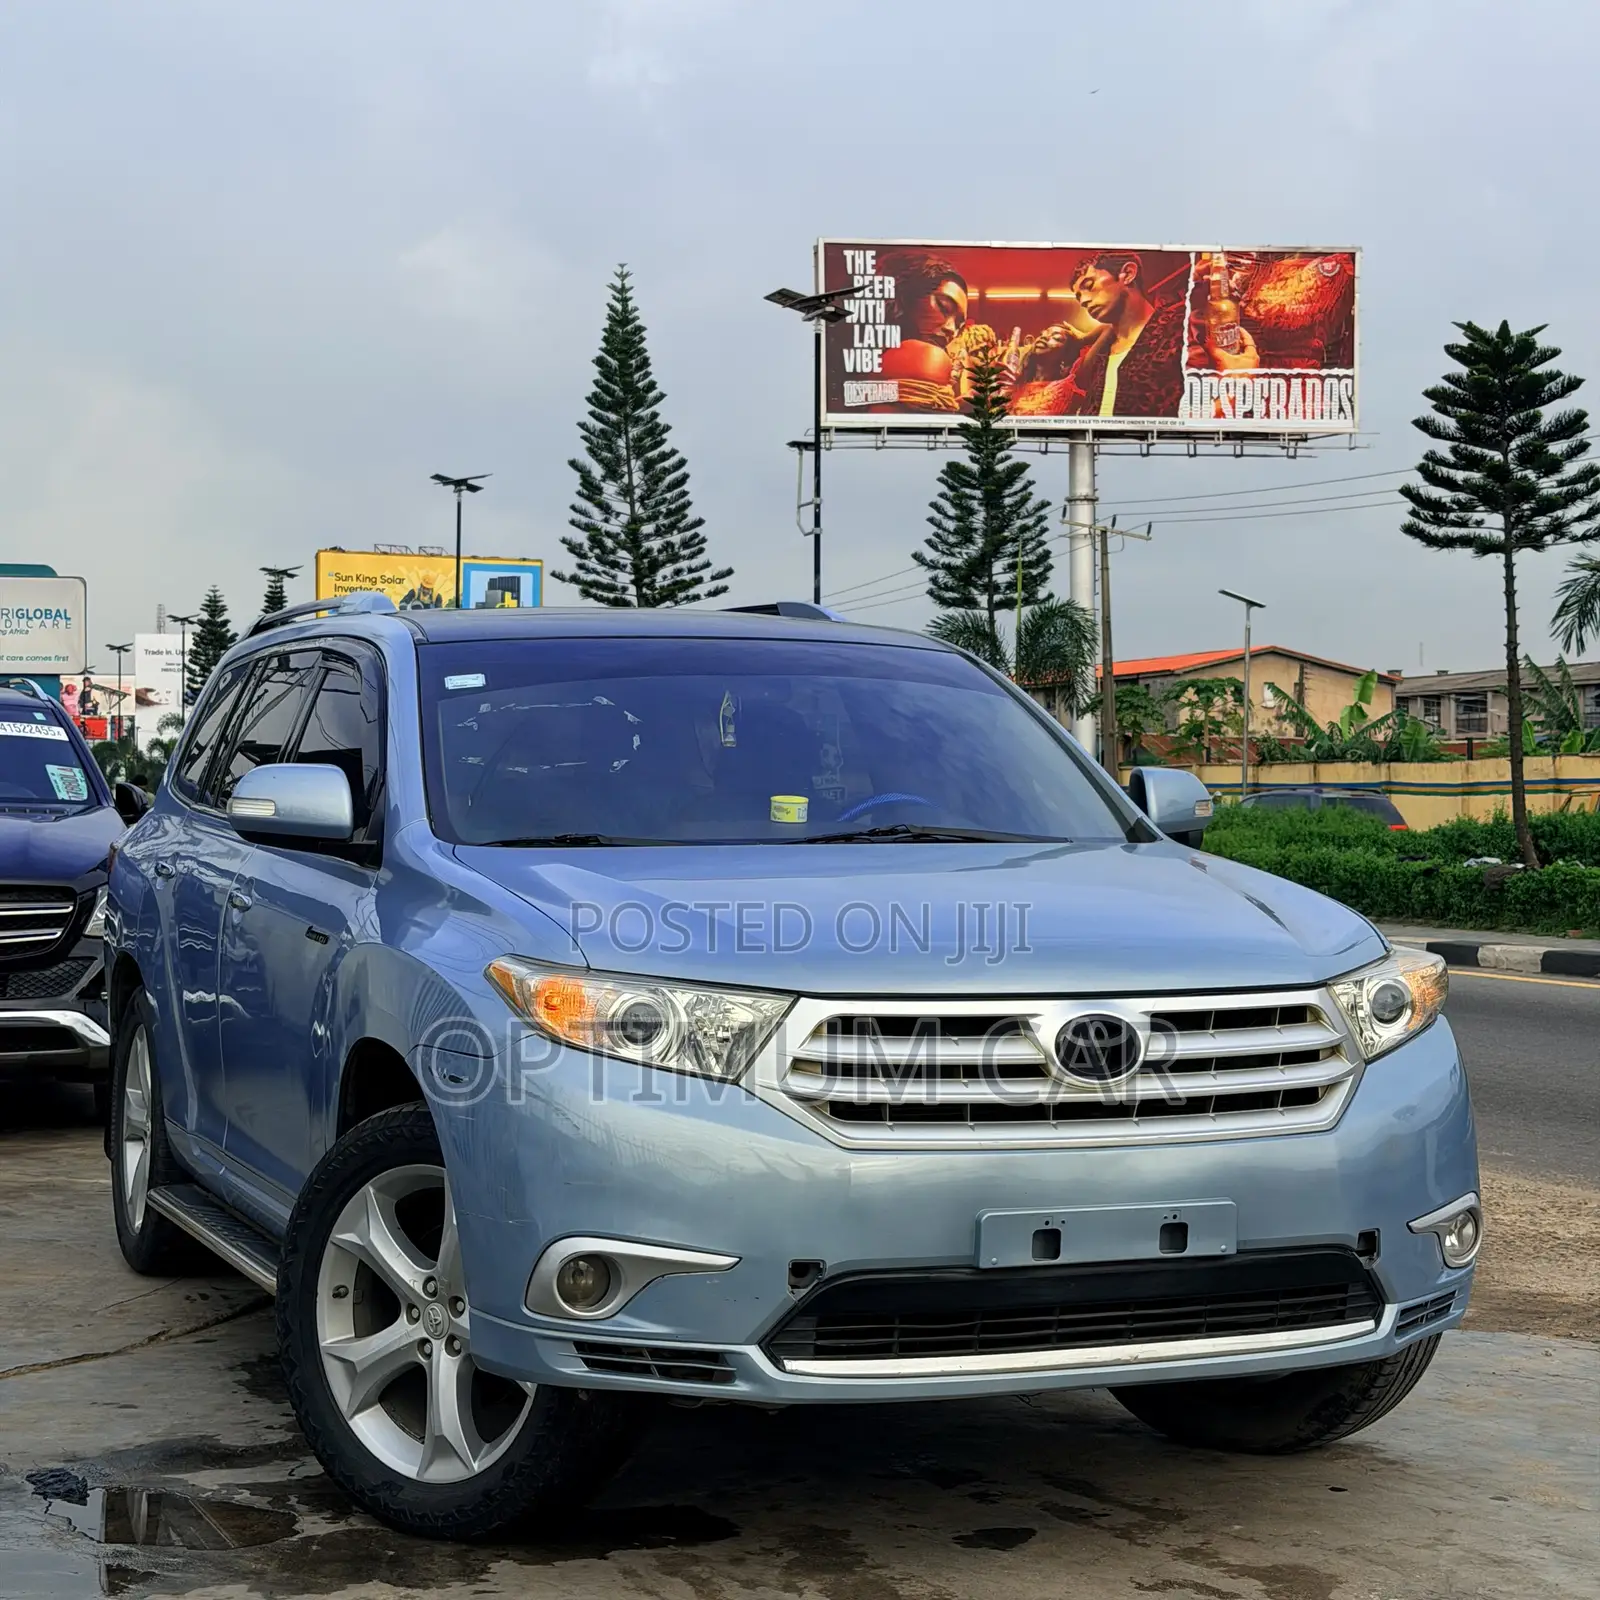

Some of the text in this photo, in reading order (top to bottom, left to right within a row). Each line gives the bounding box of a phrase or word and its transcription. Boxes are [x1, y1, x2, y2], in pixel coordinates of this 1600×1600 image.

[843, 250, 876, 275] THE
[853, 276, 895, 299] BEER
[844, 300, 885, 324] WITH
[853, 325, 901, 349] LATIN
[843, 349, 883, 374] VIBE
[844, 382, 899, 404] DESPERADOS
[1180, 376, 1355, 421] DESPERADOS
[355, 573, 378, 586] King
[380, 575, 406, 585] Solar
